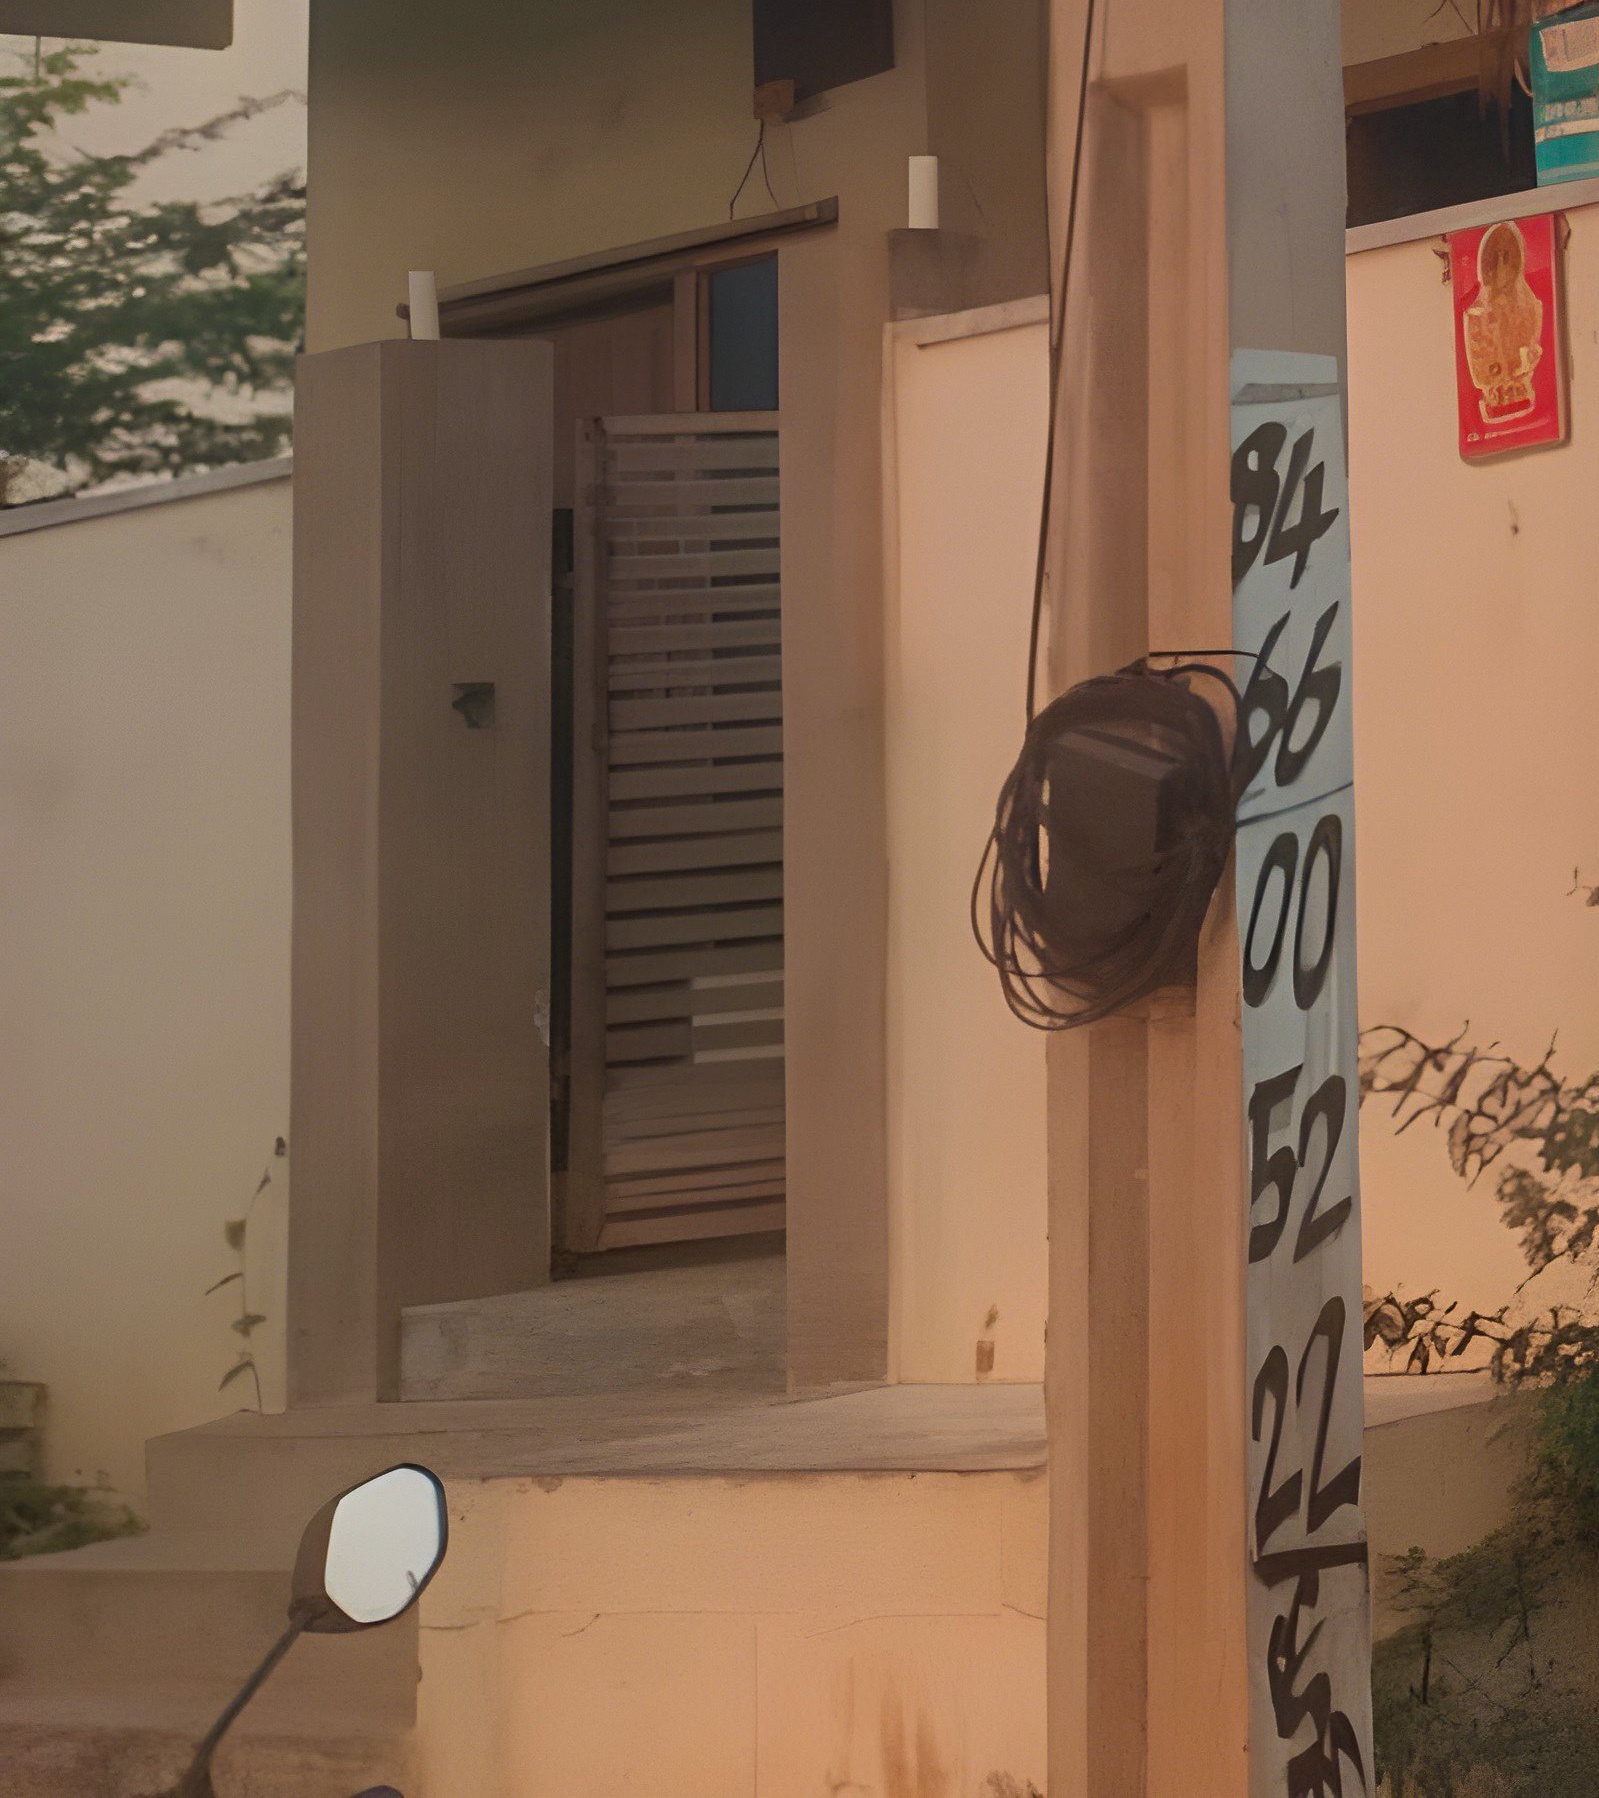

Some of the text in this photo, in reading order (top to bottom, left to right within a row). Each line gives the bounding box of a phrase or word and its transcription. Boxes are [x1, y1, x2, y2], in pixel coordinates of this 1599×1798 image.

[1230, 421, 1340, 594] 84
[1235, 601, 1342, 804] 66
[1243, 813, 1342, 1010] 00
[1248, 1062, 1352, 1264] 52
[1252, 1295, 1362, 1562] 22
